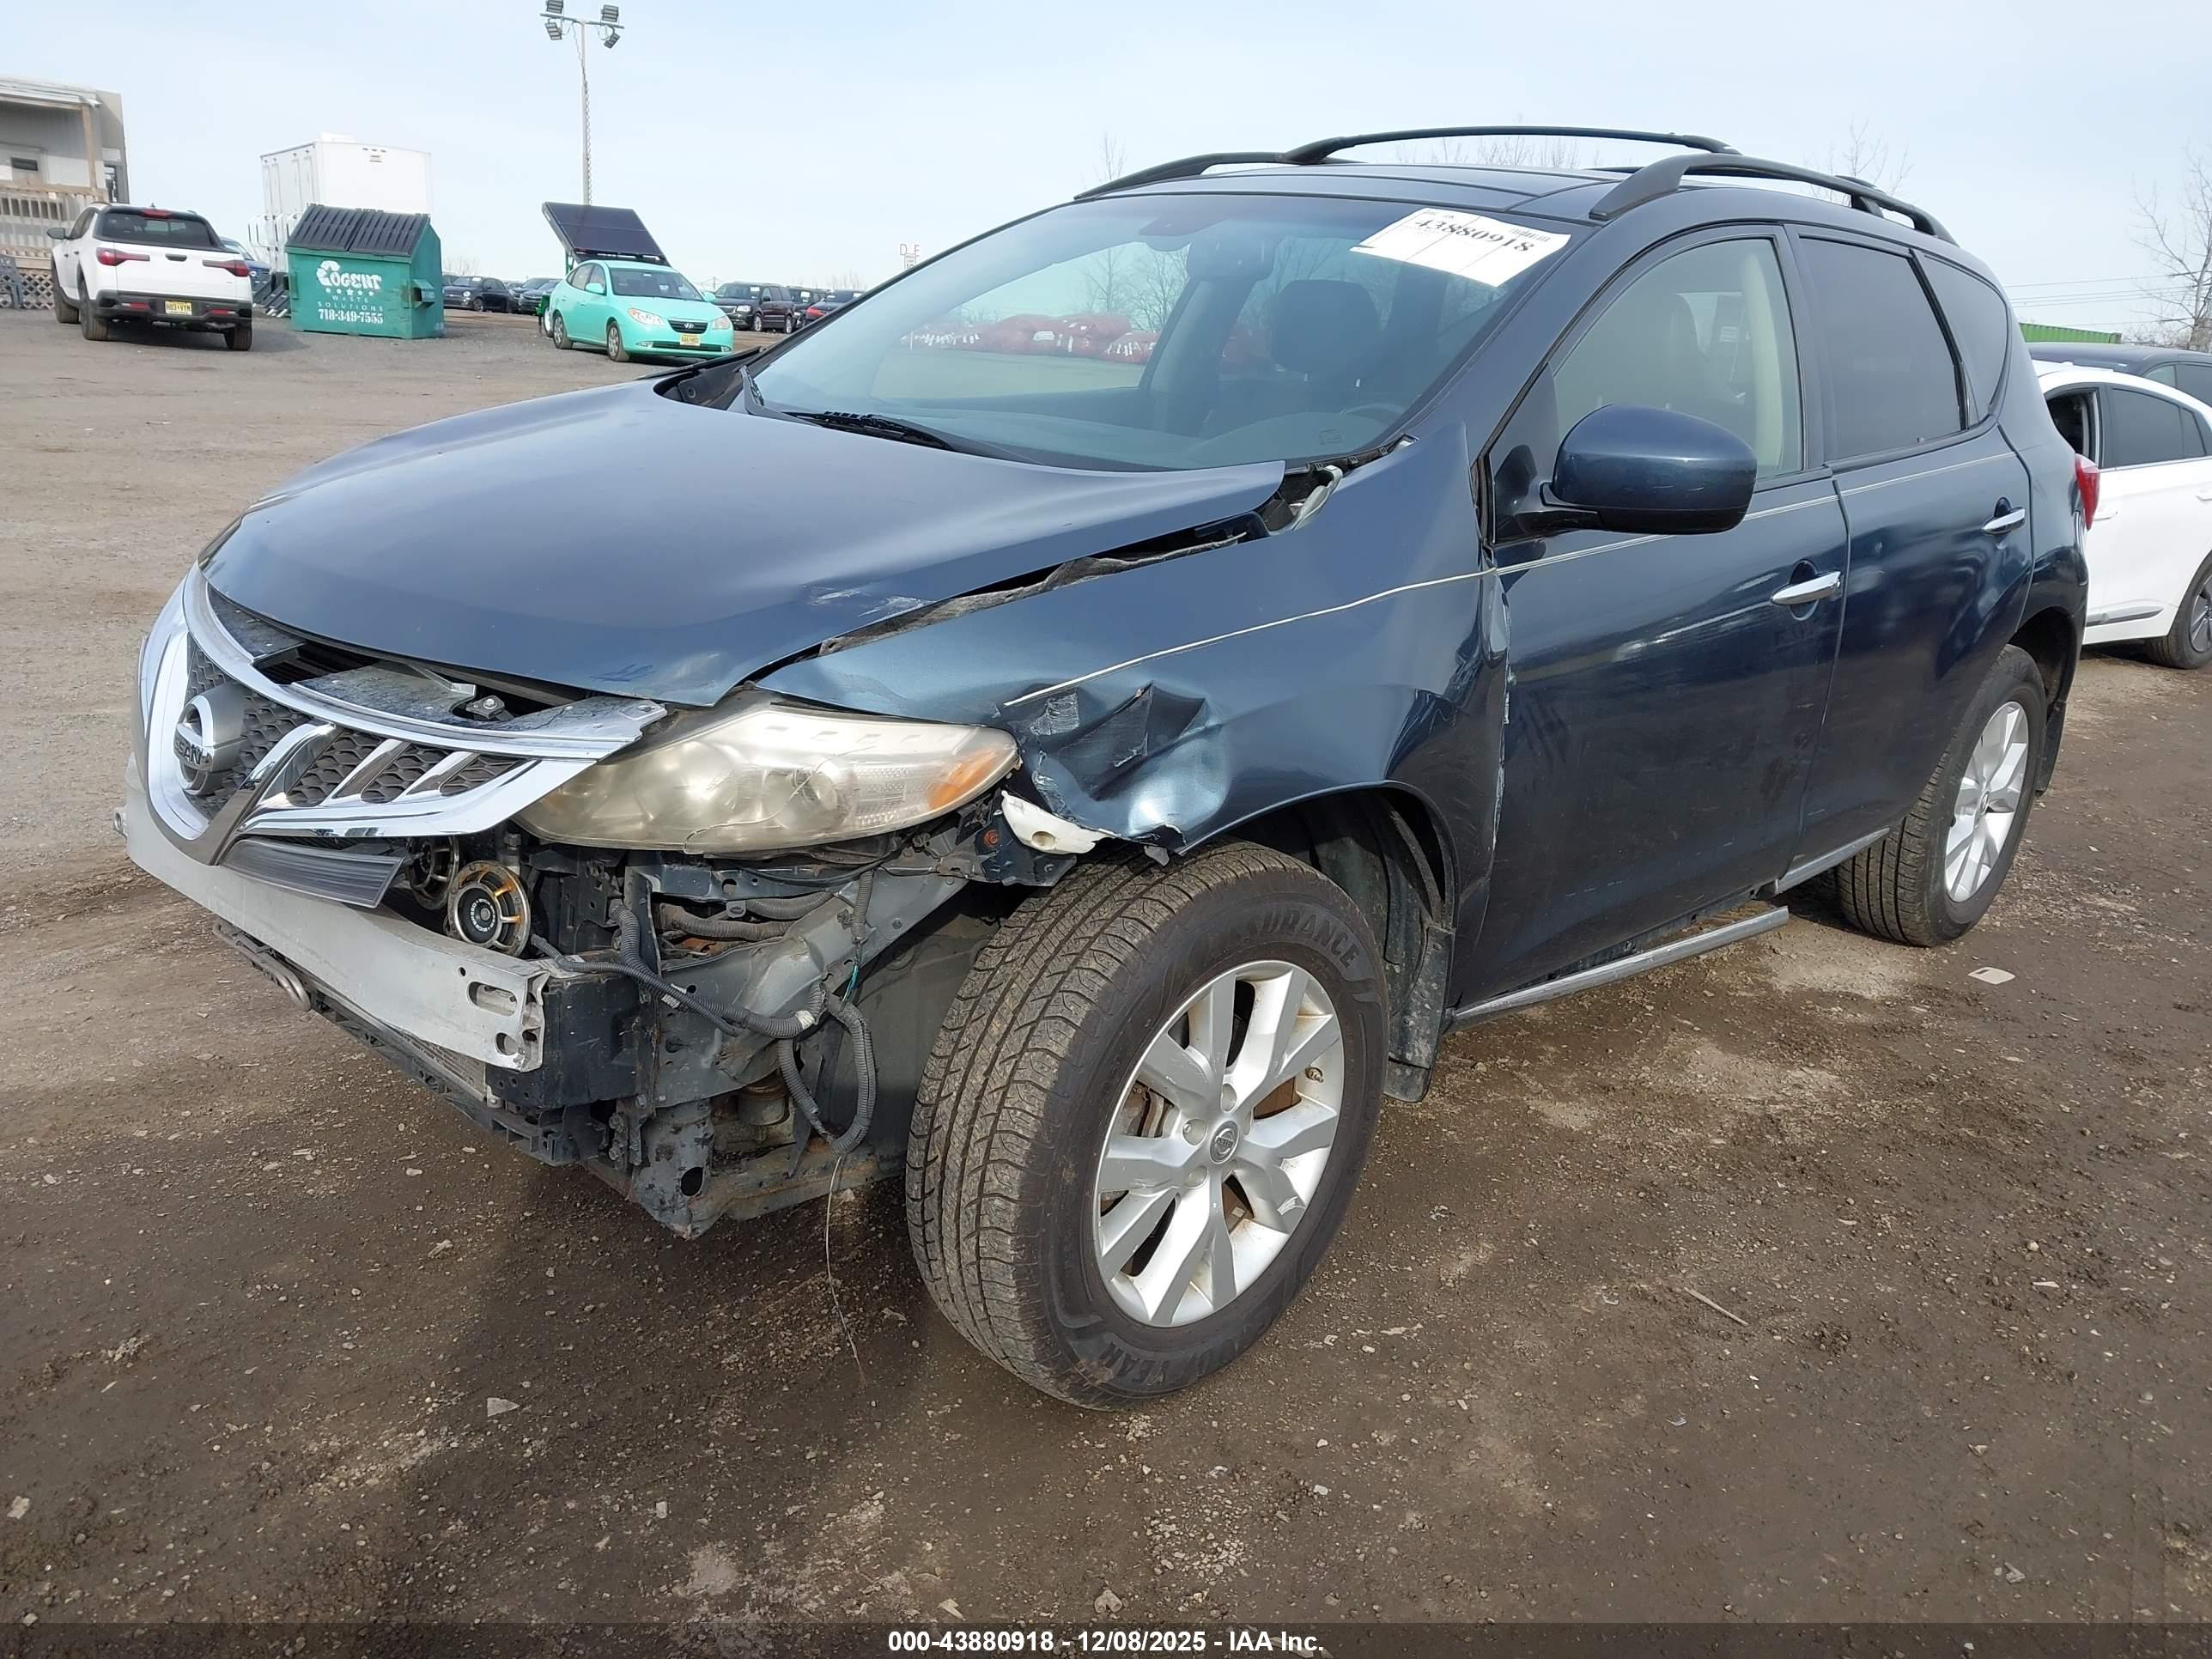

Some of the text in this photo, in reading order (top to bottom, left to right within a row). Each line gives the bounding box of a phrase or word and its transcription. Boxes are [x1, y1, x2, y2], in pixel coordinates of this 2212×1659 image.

[1415, 218, 1534, 252] 43880918
[316, 260, 382, 290] COGENT
[318, 301, 383, 311] SOLUTIONS
[331, 295, 368, 303] WASTE
[318, 308, 384, 324] 718-349-7555
